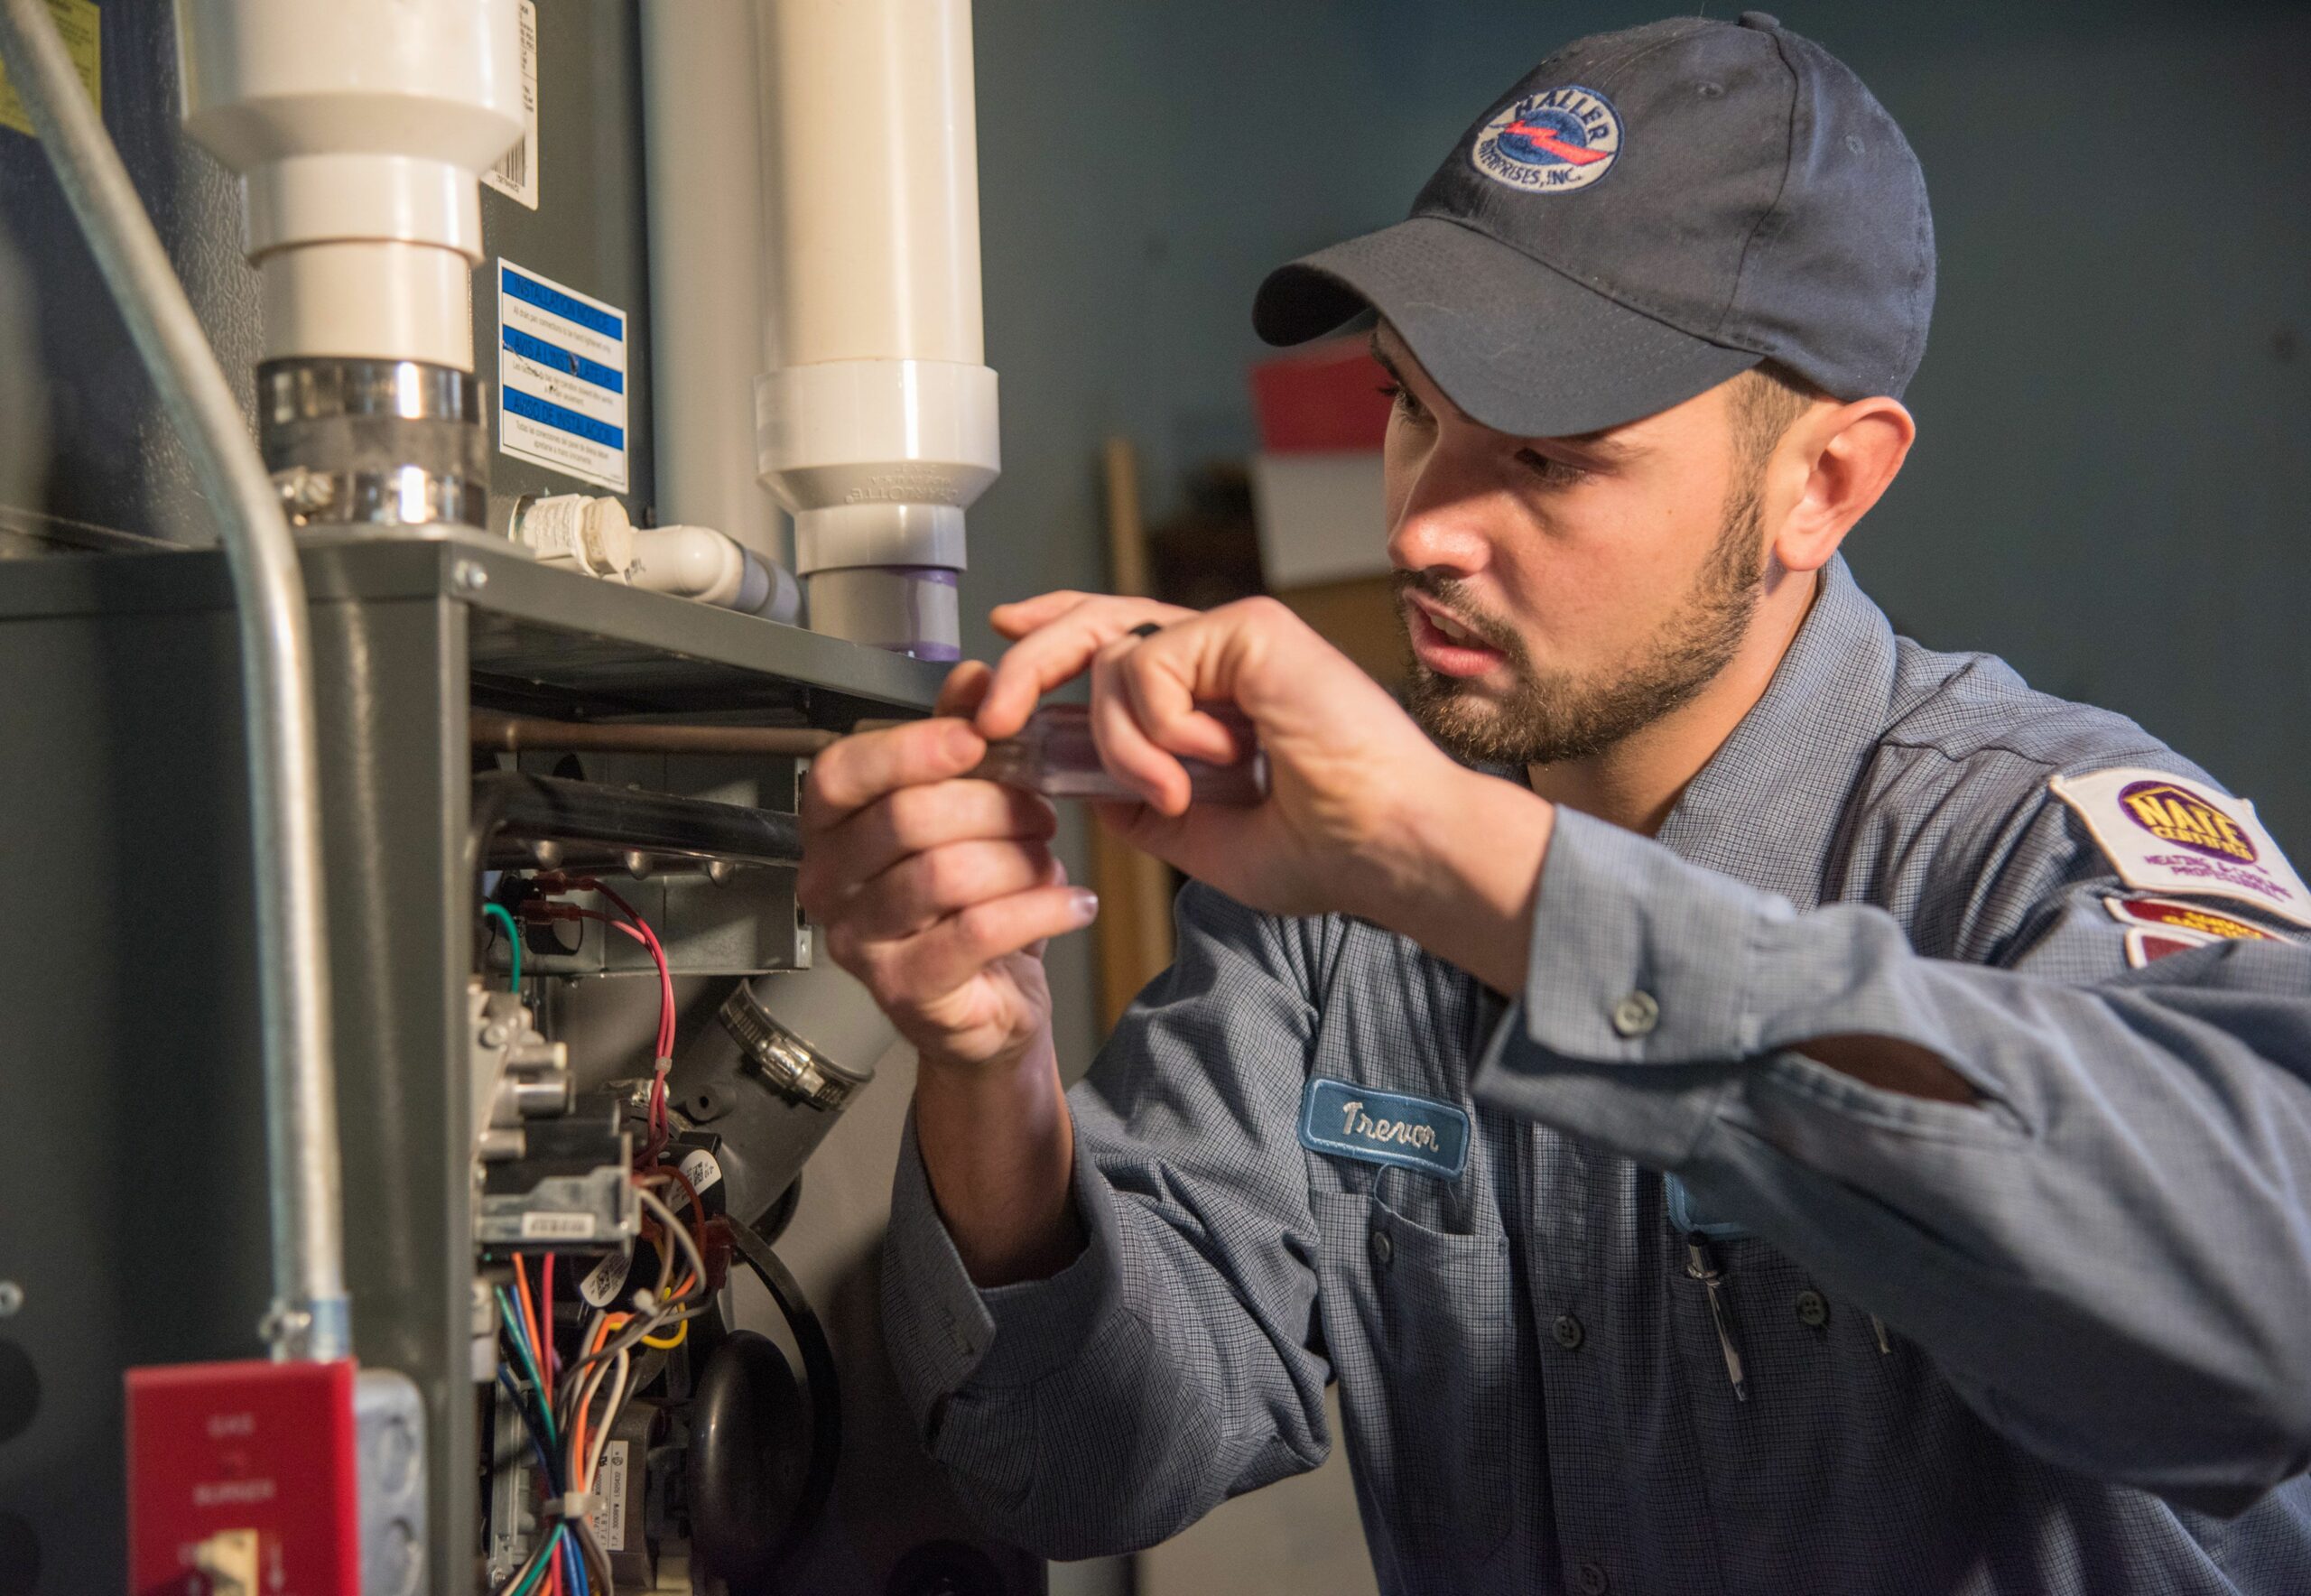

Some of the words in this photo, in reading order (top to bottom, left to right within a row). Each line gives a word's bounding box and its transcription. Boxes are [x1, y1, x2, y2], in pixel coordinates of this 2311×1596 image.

[1515, 91, 1610, 143] HALLER
[850, 485, 959, 502] CHARLOTTE
[2127, 795, 2247, 849] NATE
[1342, 1100, 1440, 1154] Trevor
